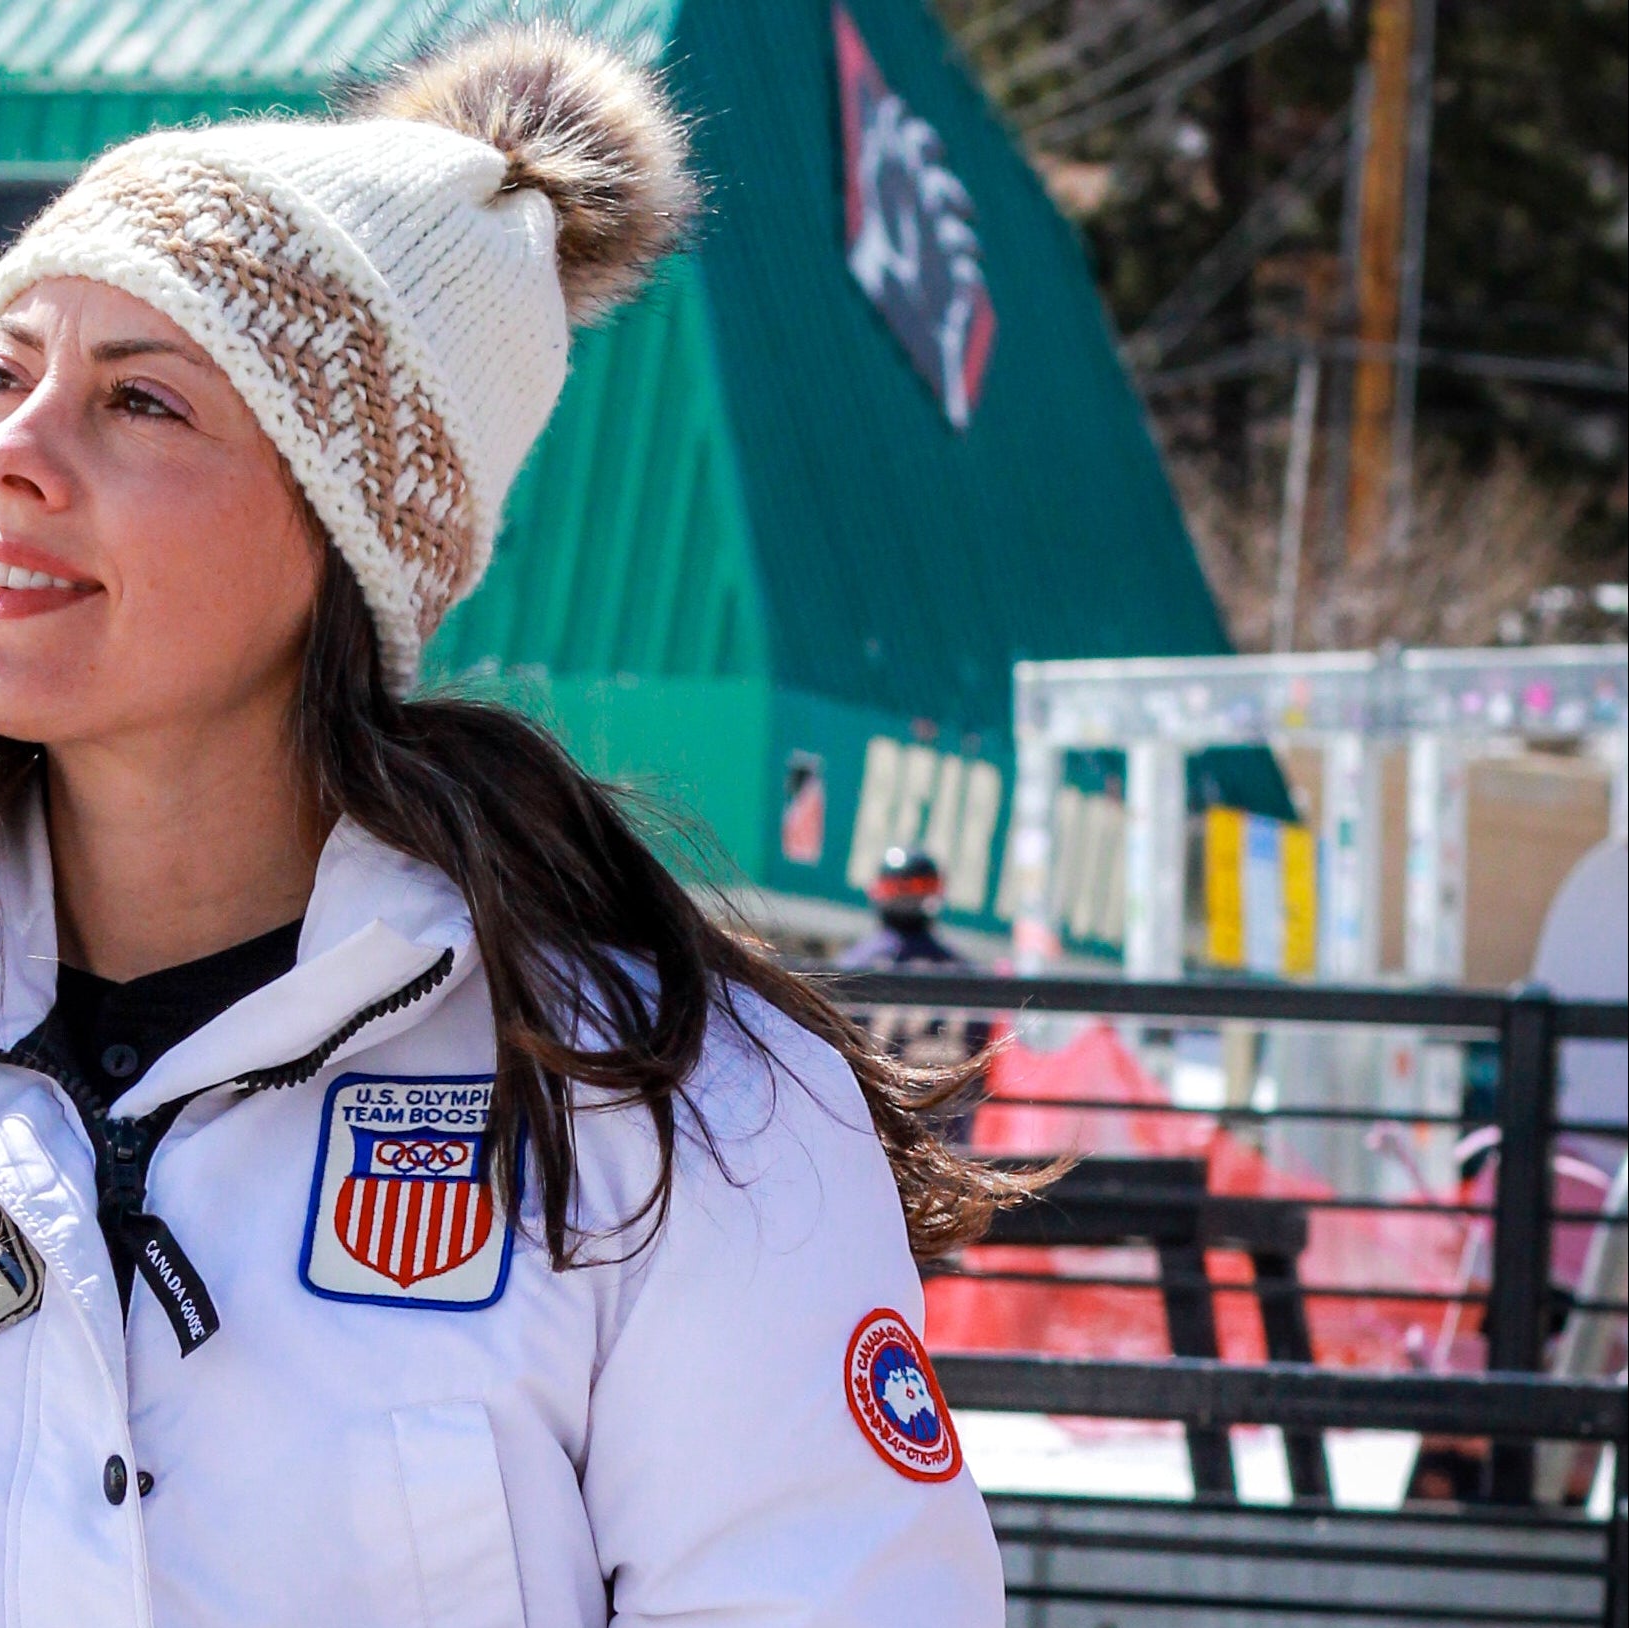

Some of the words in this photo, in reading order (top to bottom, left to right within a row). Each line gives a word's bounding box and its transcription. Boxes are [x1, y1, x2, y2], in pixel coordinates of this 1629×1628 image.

[356, 1088, 398, 1105] U.S.
[406, 1089, 489, 1106] OLYMPI
[342, 1106, 405, 1124] TEAM
[409, 1107, 490, 1125] BOOST
[145, 1239, 187, 1302] CANADA
[180, 1298, 206, 1341] GOOSE
[857, 1326, 889, 1370] CANADA
